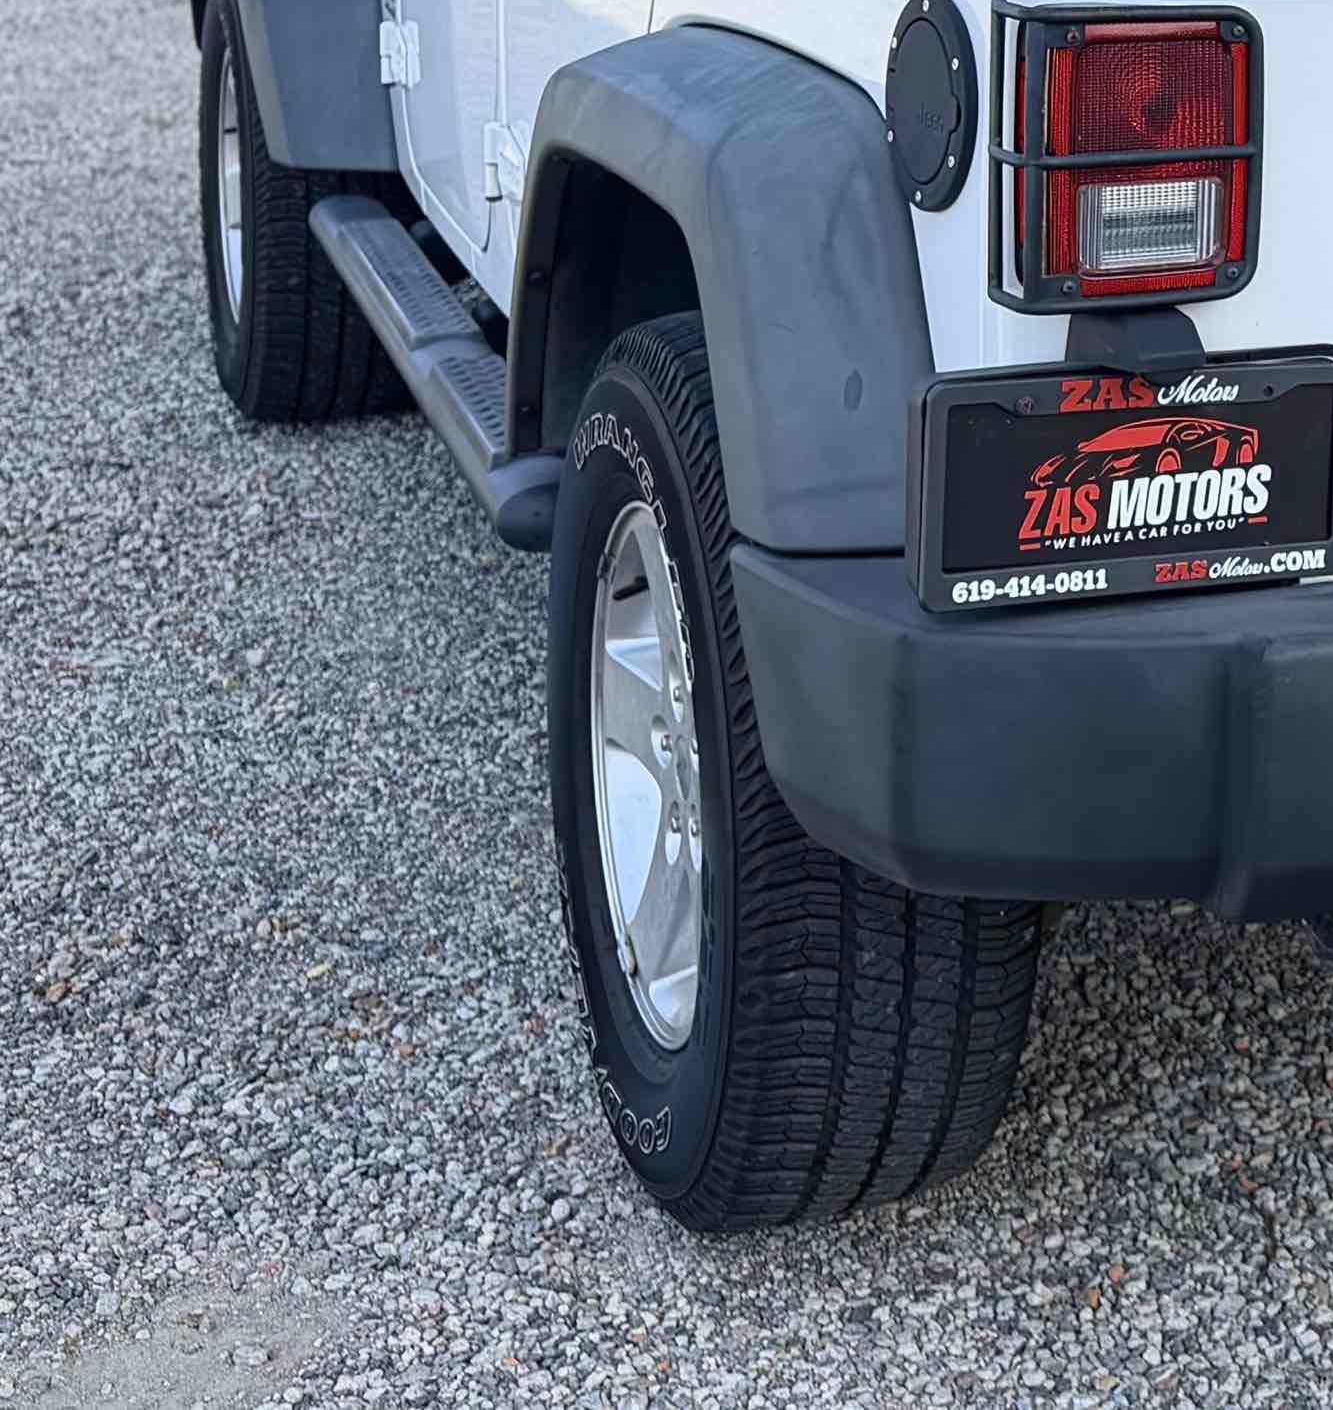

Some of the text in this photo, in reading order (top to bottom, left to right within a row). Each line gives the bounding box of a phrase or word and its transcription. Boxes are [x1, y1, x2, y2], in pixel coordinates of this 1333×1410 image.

[1059, 374, 1239, 413] ZAS Motors
[1018, 464, 1272, 539] ZAS MOTORS
[1081, 533, 1120, 547] HAVE
[1124, 531, 1134, 541] A
[1138, 528, 1168, 540] CAR
[1173, 525, 1201, 536] FOR
[952, 569, 1109, 604] 619-414-0811
